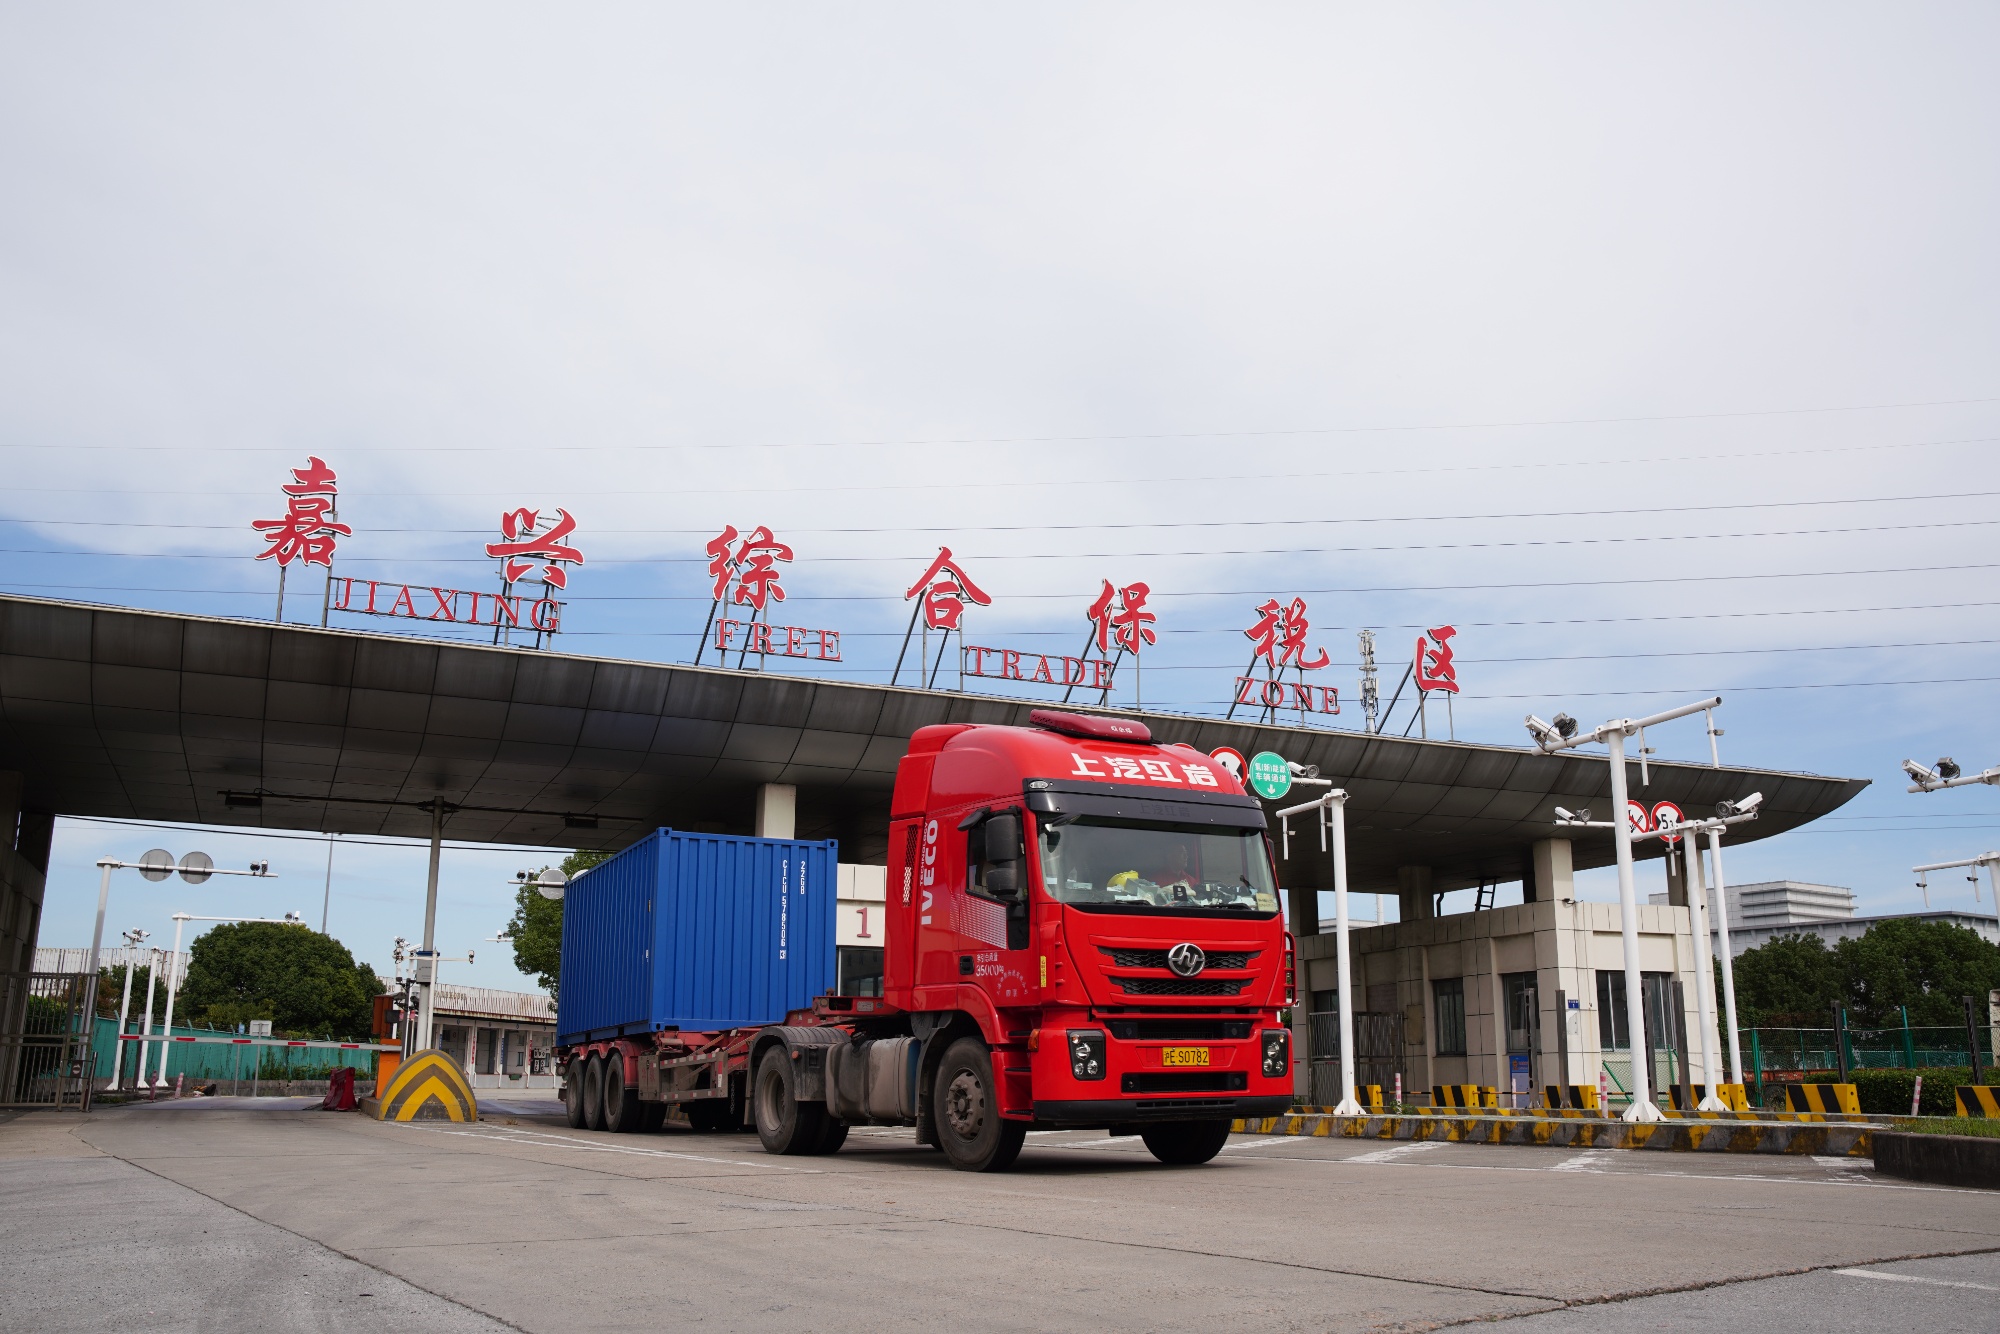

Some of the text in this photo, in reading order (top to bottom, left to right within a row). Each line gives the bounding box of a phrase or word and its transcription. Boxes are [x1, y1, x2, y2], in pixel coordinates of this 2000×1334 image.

[252, 455, 1460, 695] 嘉兴综合保税区
[335, 576, 1341, 715] JIAXING FREE TRADE ZONE
[1071, 752, 1218, 787] 上汽红岩
[855, 906, 872, 939] 1
[921, 819, 939, 926] IVECO
